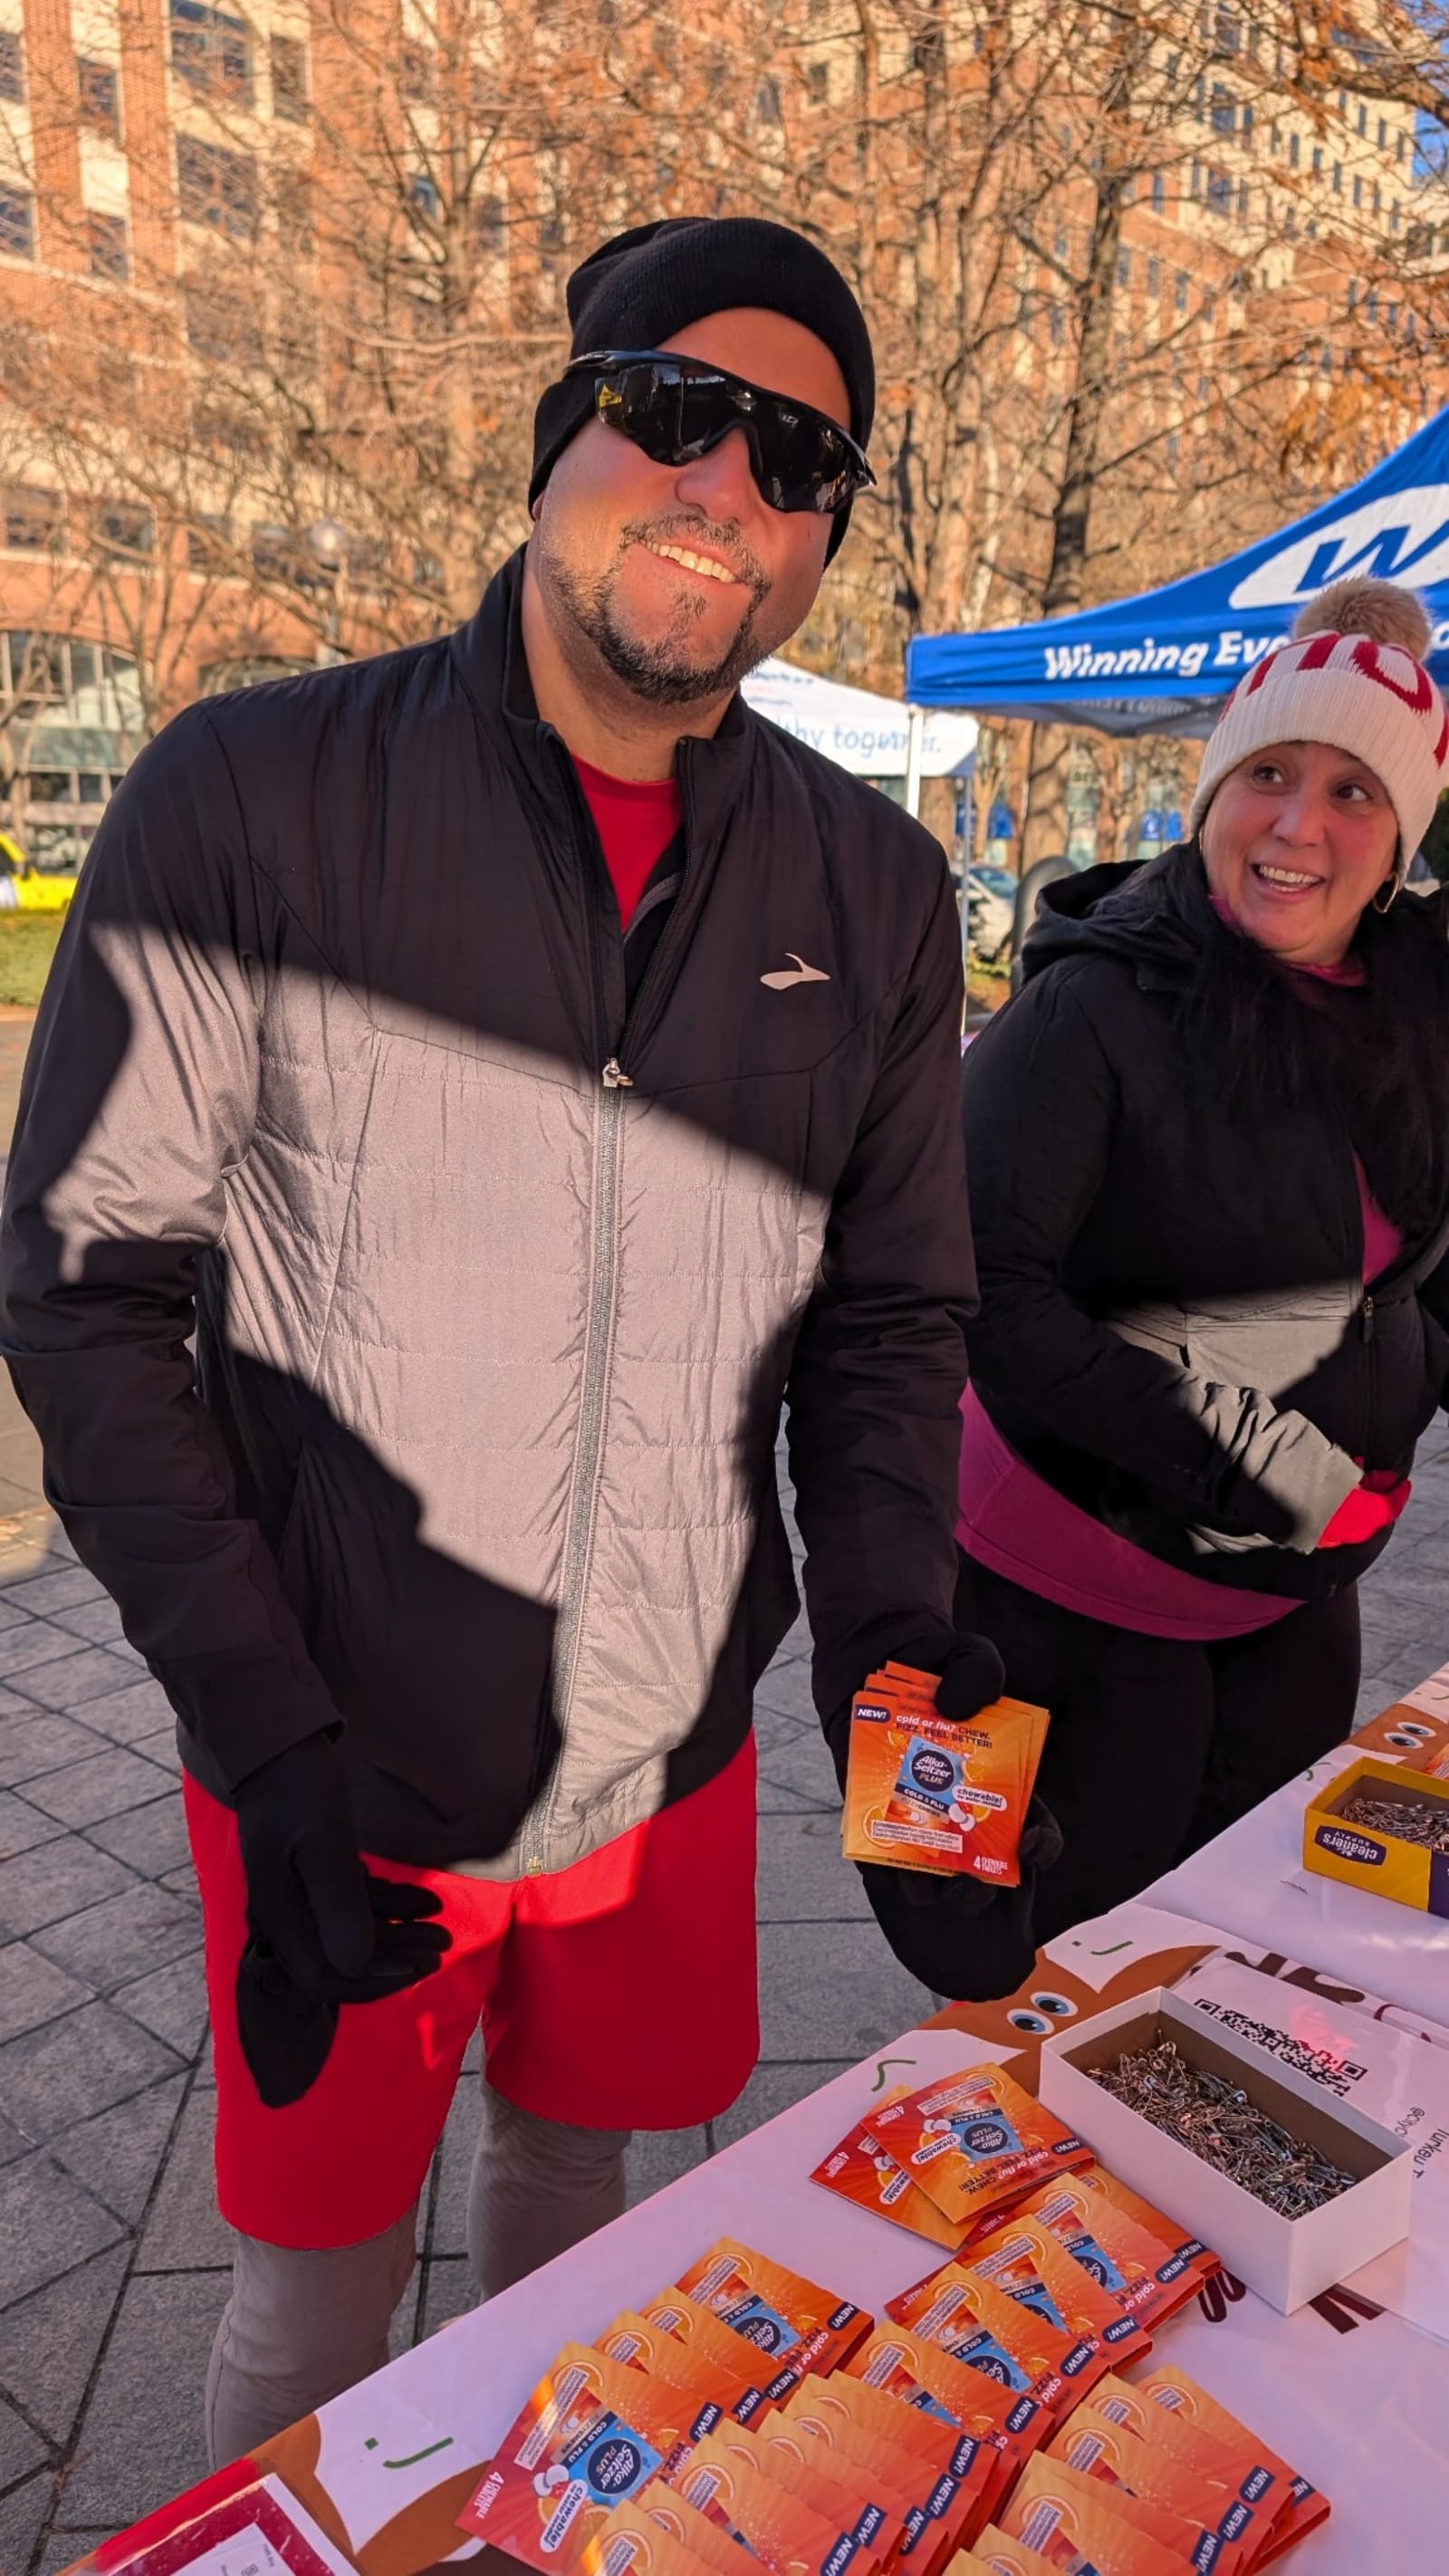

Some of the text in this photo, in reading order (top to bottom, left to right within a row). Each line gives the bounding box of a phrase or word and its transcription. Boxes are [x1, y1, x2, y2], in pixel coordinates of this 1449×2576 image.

[1044, 638, 1208, 681] Winning
[858, 1707, 887, 1719] NEW!
[896, 1713, 991, 1740] cold or flu? CHEW.
[896, 1723, 993, 1749] FIZZ. FEEL BETTER!
[914, 1761, 952, 1778] Seltzer
[919, 1754, 948, 1768] Alka-
[919, 1773, 945, 1785] PLUS
[904, 1788, 925, 1802] COLD
[929, 1798, 945, 1810] FLU
[957, 1788, 1003, 1802] chewable!
[1322, 1832, 1378, 1860] cleaners
[1334, 1831, 1370, 1846] SUPPLY
[974, 1855, 981, 1871] 4
[972, 2127, 993, 2138] PLUS
[1394, 2107, 1425, 2138] @CityC
[916, 2135, 958, 2163] chewable!
[970, 2129, 1003, 2147] Seltzer
[1056, 2139, 1080, 2153] NEW!
[1016, 2158, 1027, 2169] or
[1028, 2151, 1049, 2166] cold
[959, 2166, 995, 2191] BETTER!
[997, 2165, 1016, 2179] flu?
[964, 2177, 996, 2196] CHEW.
[1179, 2242, 1203, 2260] NEW!
[1159, 2258, 1185, 2282] NEW!
[1014, 2287, 1036, 2299] COLD
[1137, 2282, 1156, 2303] cold
[734, 2302, 753, 2317] COLD
[833, 2304, 855, 2328] NEW!
[1124, 2301, 1135, 2312] or
[744, 2321, 760, 2337] PLU
[751, 2321, 771, 2345] Seltz
[1108, 2319, 1136, 2341] NEW!
[759, 2331, 774, 2350] Alk
[810, 2331, 830, 2356] cold
[964, 2338, 983, 2352] COLD
[801, 2353, 812, 2366] or
[1064, 2347, 1089, 2375] NEW!
[770, 2372, 795, 2399] NEW!
[1041, 2378, 1061, 2403] cold
[738, 2390, 760, 2421] NEW
[1010, 2399, 1033, 2431] NEW!
[588, 2421, 608, 2441] COLD
[695, 2405, 718, 2438] NEW!
[568, 2447, 584, 2464] FLU
[595, 2445, 618, 2476] PLUS
[601, 2444, 631, 2489] Seltzer
[954, 2438, 974, 2475] NEW!
[488, 2471, 504, 2485] 4
[612, 2450, 635, 2489] Alka-
[930, 2477, 955, 2515] NEW!
[1244, 2470, 1269, 2500] NEW!
[1293, 2481, 1310, 2496] NE
[559, 2493, 572, 2514] water
[544, 2514, 561, 2543] needed
[551, 2486, 583, 2549] chewable!
[1223, 2504, 1248, 2540] NEW!
[825, 2538, 853, 2576] NEW!
[1195, 2535, 1218, 2573] NEW!
